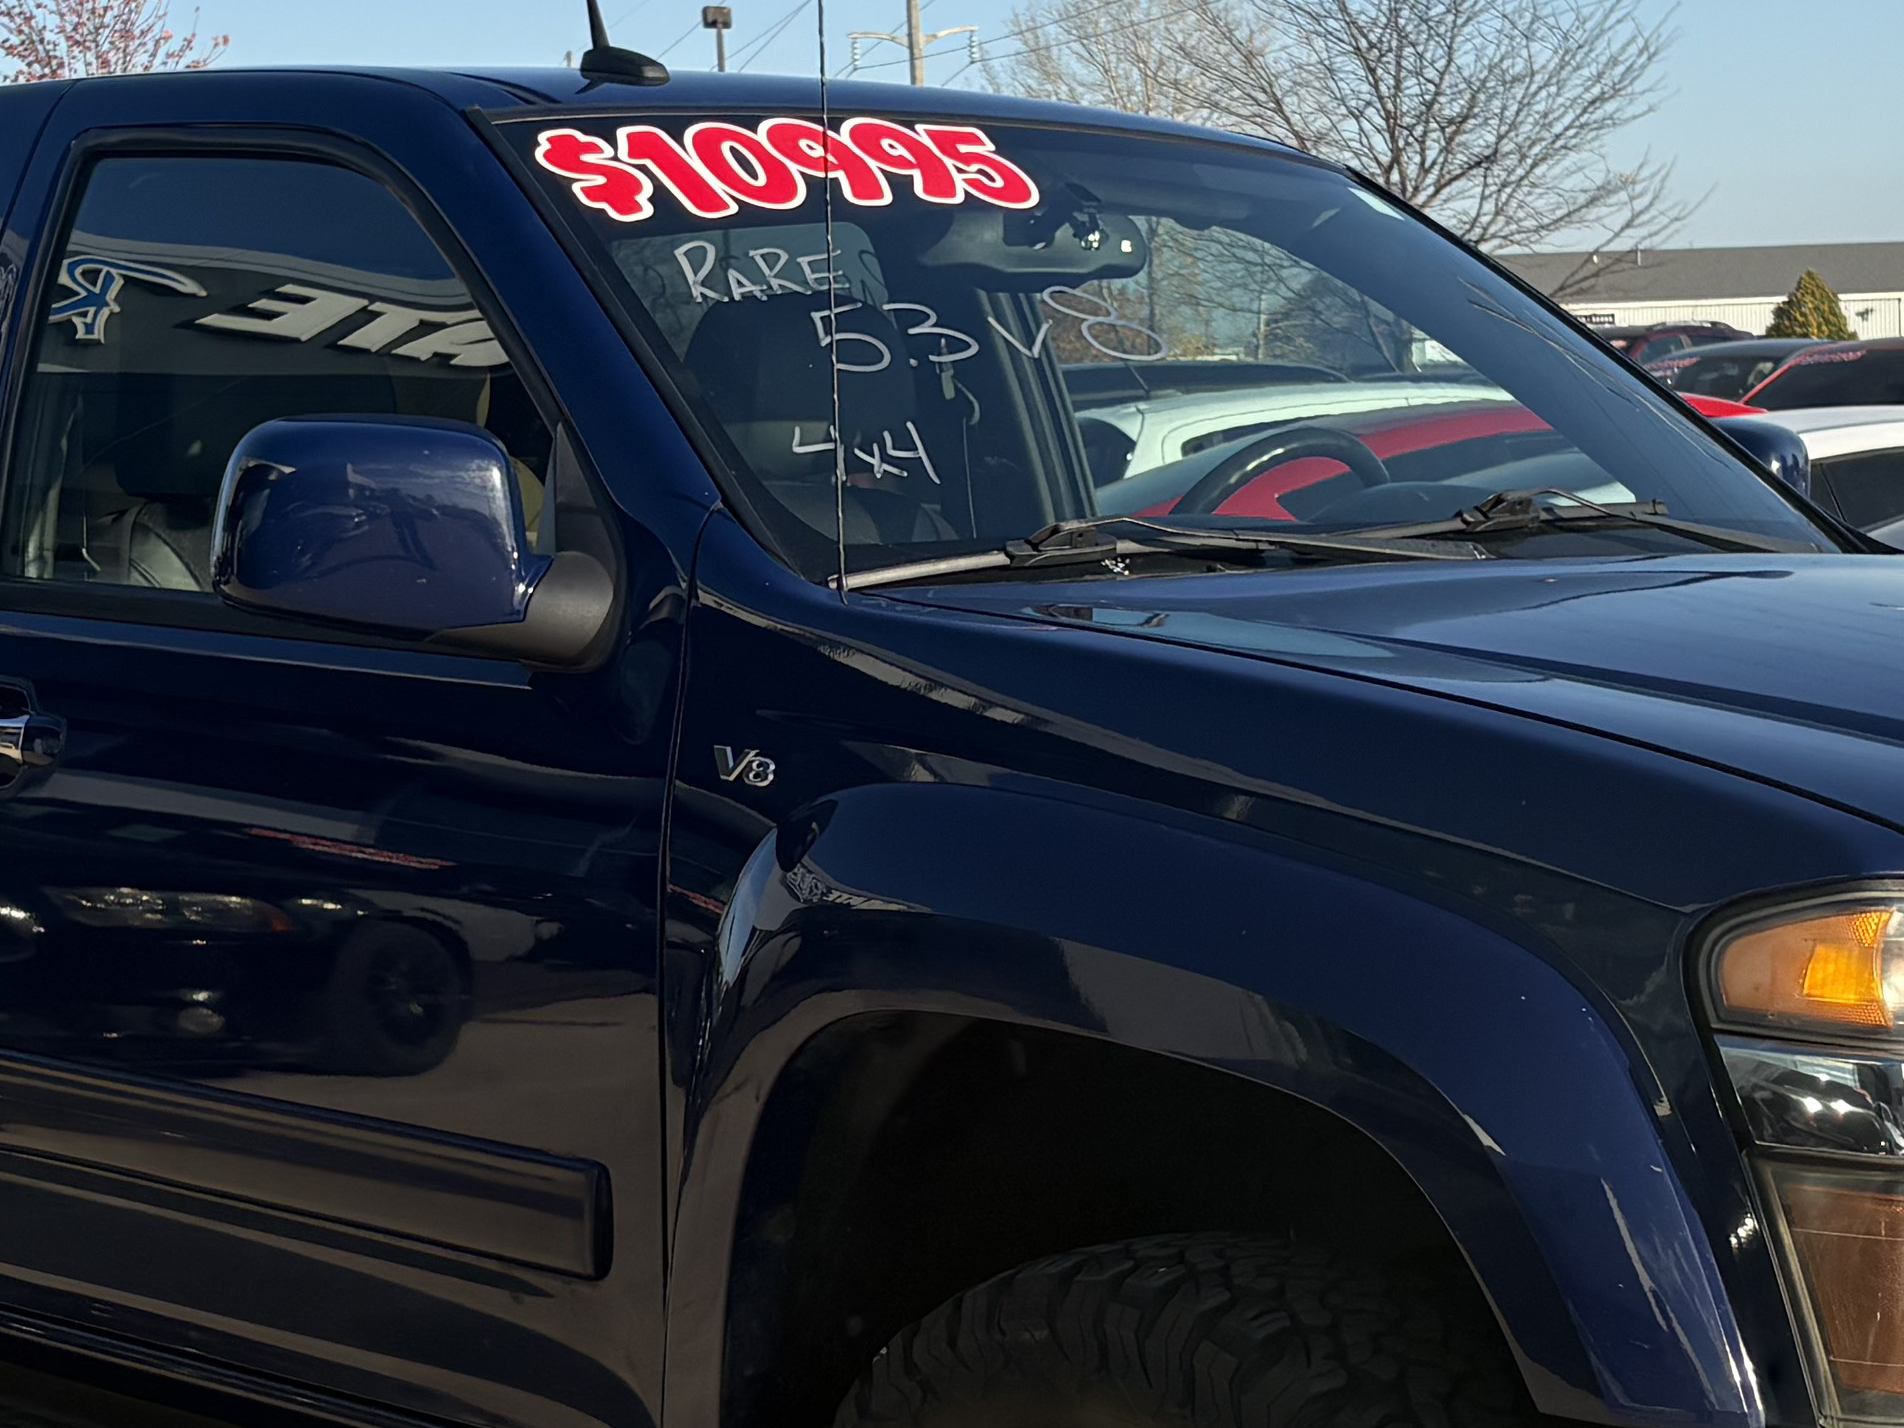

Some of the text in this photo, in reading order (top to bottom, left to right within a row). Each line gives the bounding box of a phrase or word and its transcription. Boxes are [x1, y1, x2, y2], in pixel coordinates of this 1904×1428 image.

[535, 118, 1040, 222] $10995
[673, 240, 850, 303] RARE
[810, 285, 1168, 372] 5.3 V8
[713, 744, 776, 787] V8
